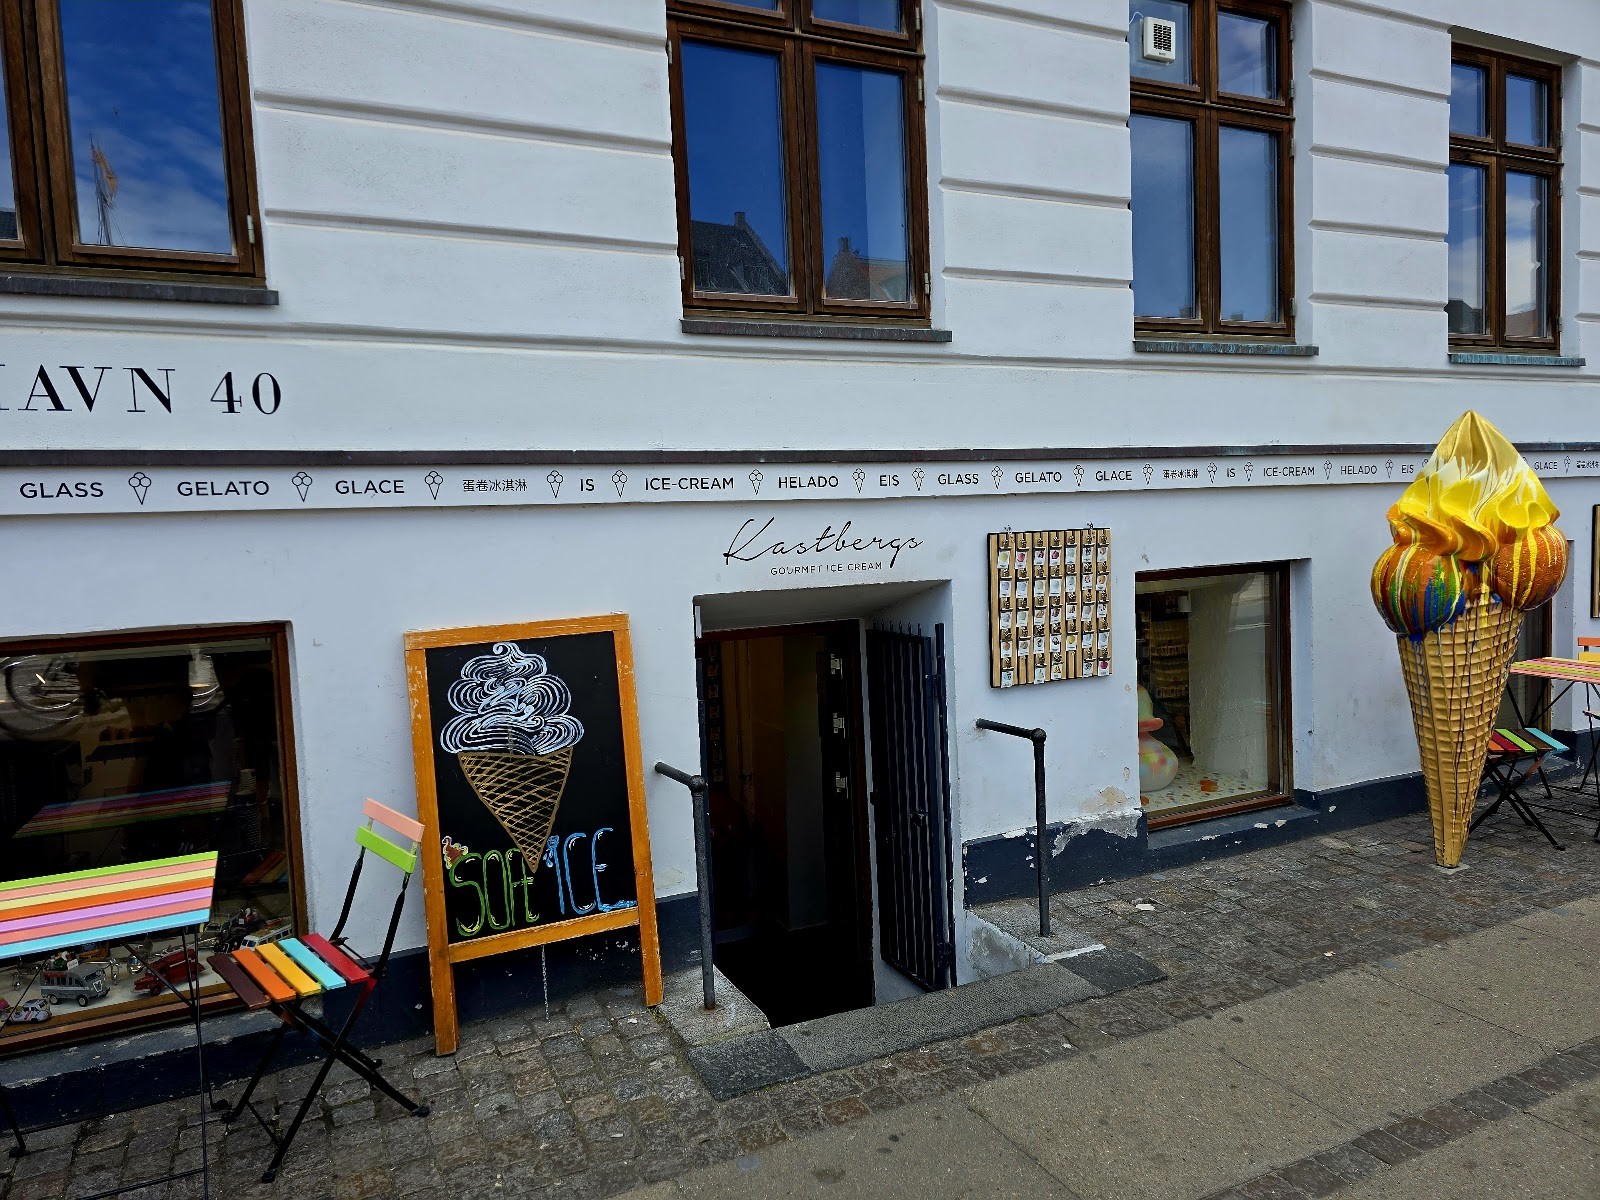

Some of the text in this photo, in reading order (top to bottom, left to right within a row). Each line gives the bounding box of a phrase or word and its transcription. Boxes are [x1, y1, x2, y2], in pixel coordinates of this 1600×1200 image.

[0, 364, 282, 415] AVN 40
[19, 481, 104, 499] GLASS
[176, 480, 270, 497] GELATO
[335, 479, 405, 495] GLACE
[462, 478, 529, 493] 蛋卷冰淇淋
[580, 478, 595, 492] IS
[645, 476, 734, 491] ICE-CREAM
[778, 475, 839, 489] HELADO
[879, 474, 900, 487] EIS
[937, 473, 980, 486] GLASS
[1014, 471, 1063, 484] GELATO
[1095, 470, 1133, 482] GLACE
[1226, 467, 1236, 478] IS
[1263, 466, 1315, 477] ICE-CREAM
[1340, 464, 1378, 475] HELADO
[1401, 464, 1415, 474] EIS
[1533, 461, 1558, 471] GLACE
[723, 517, 924, 569] Kastbergs
[826, 562, 844, 573] ICE
[847, 561, 883, 572] CREAM
[544, 828, 637, 914] ICE
